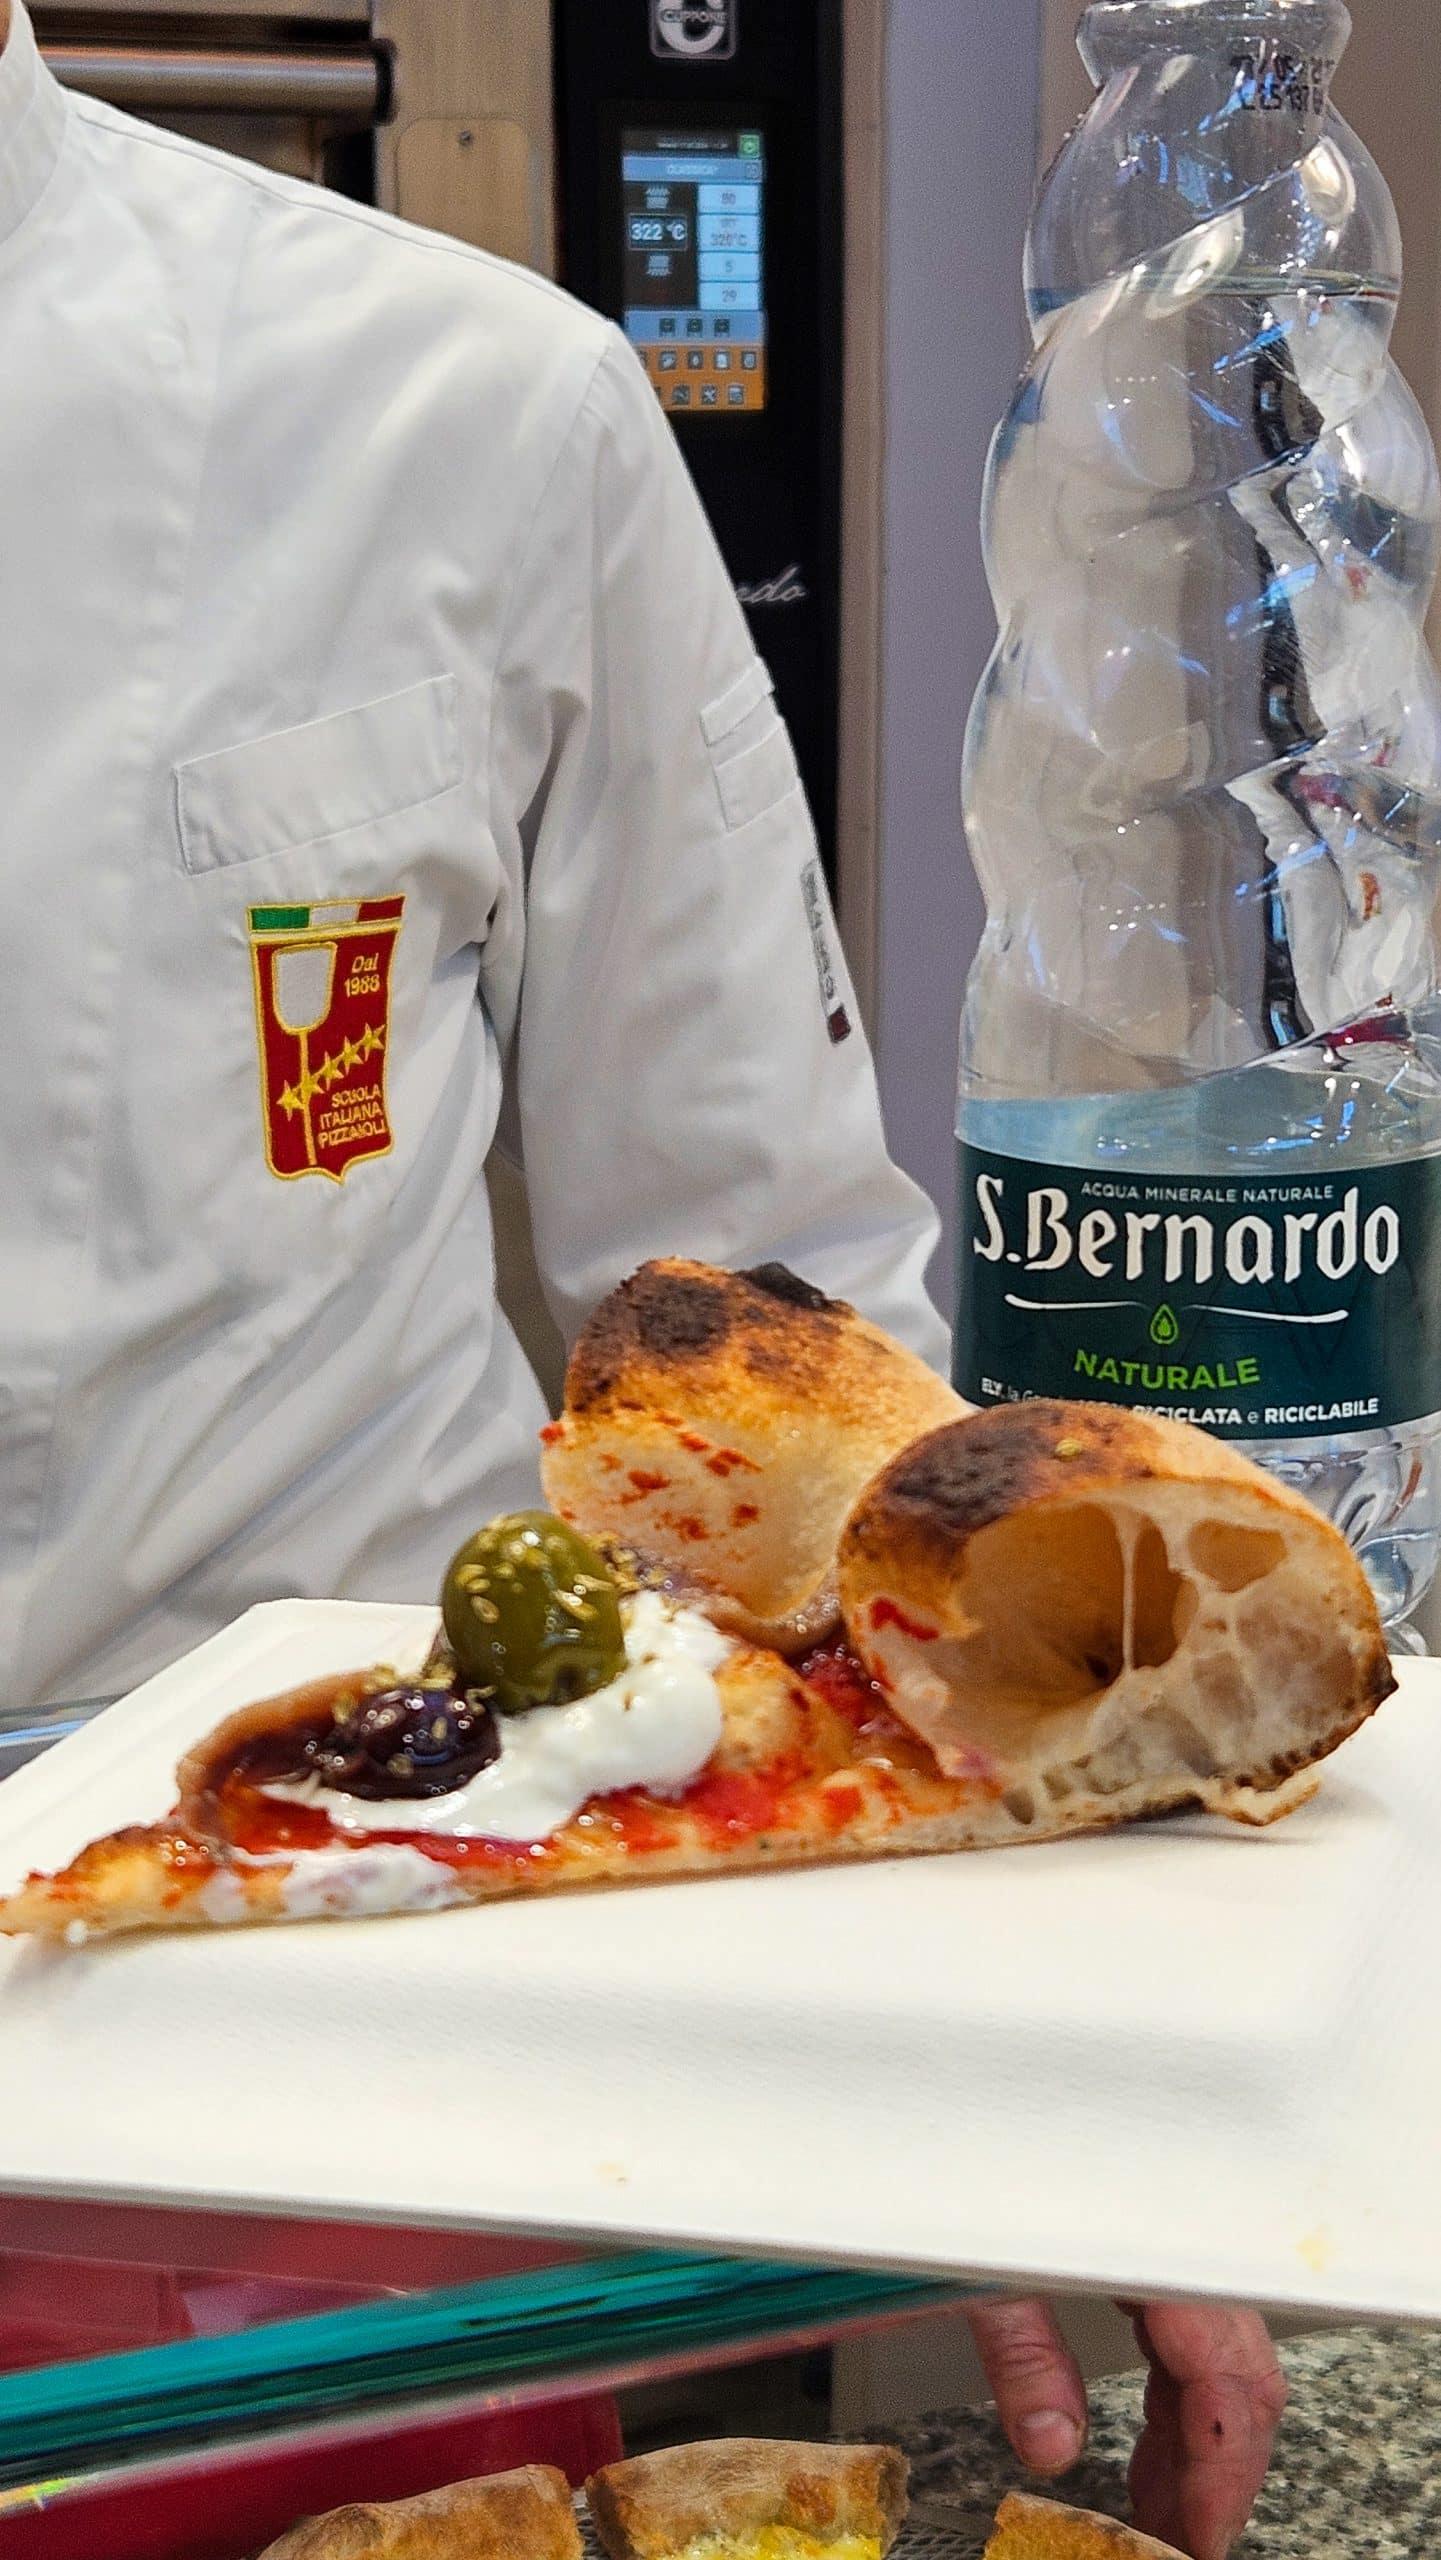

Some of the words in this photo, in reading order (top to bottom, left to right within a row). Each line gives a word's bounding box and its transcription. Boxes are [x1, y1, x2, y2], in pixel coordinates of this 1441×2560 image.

[631, 223, 663, 240] 322
[351, 952, 379, 974] Dal
[344, 974, 380, 998] 1988
[331, 1084, 382, 1108] SCUOLA
[319, 1101, 383, 1130] ITALIANA
[317, 1119, 387, 1150] PIZZAIOLI
[1080, 1181, 1139, 1200] ACQUA
[1145, 1187, 1237, 1203] MINERALE
[1243, 1185, 1333, 1202] NATURALE
[973, 1173, 1400, 1283] S.Bernardo
[1073, 1349, 1261, 1391] NATURALE
[1247, 1410, 1259, 1424] e
[1264, 1397, 1379, 1425] RICICLABILE
